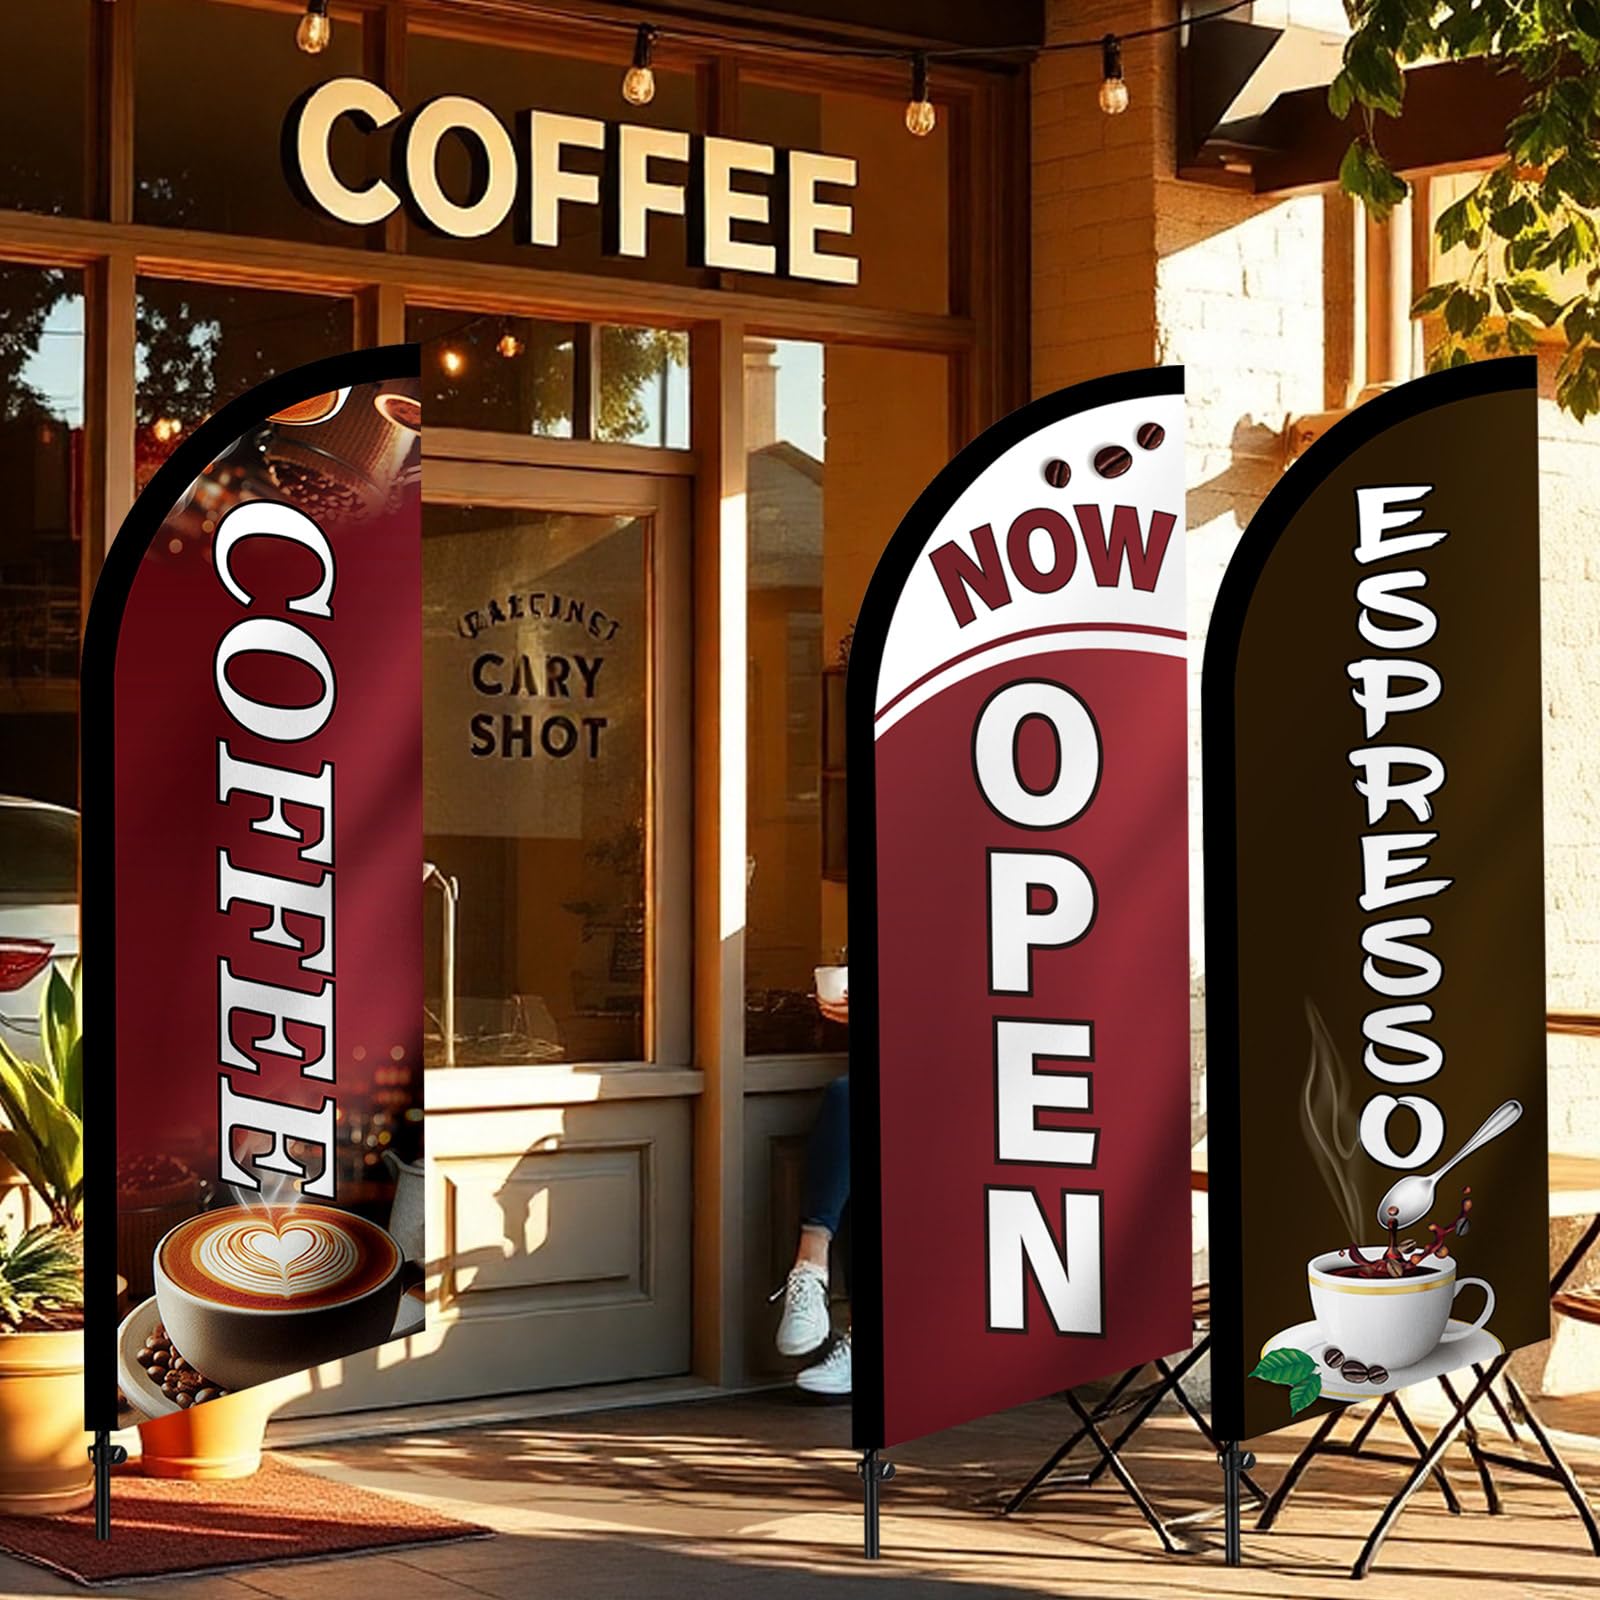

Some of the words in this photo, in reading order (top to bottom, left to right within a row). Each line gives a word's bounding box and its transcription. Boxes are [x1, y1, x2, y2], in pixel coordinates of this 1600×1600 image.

[297, 77, 860, 285] COFFEE
[928, 503, 1178, 630] NOW
[470, 712, 608, 758] SHOT
[472, 653, 604, 698] CARY
[212, 499, 336, 1199] COFFEE
[1346, 483, 1453, 1171] ESPRESSO
[972, 677, 1107, 1338] OPEN
